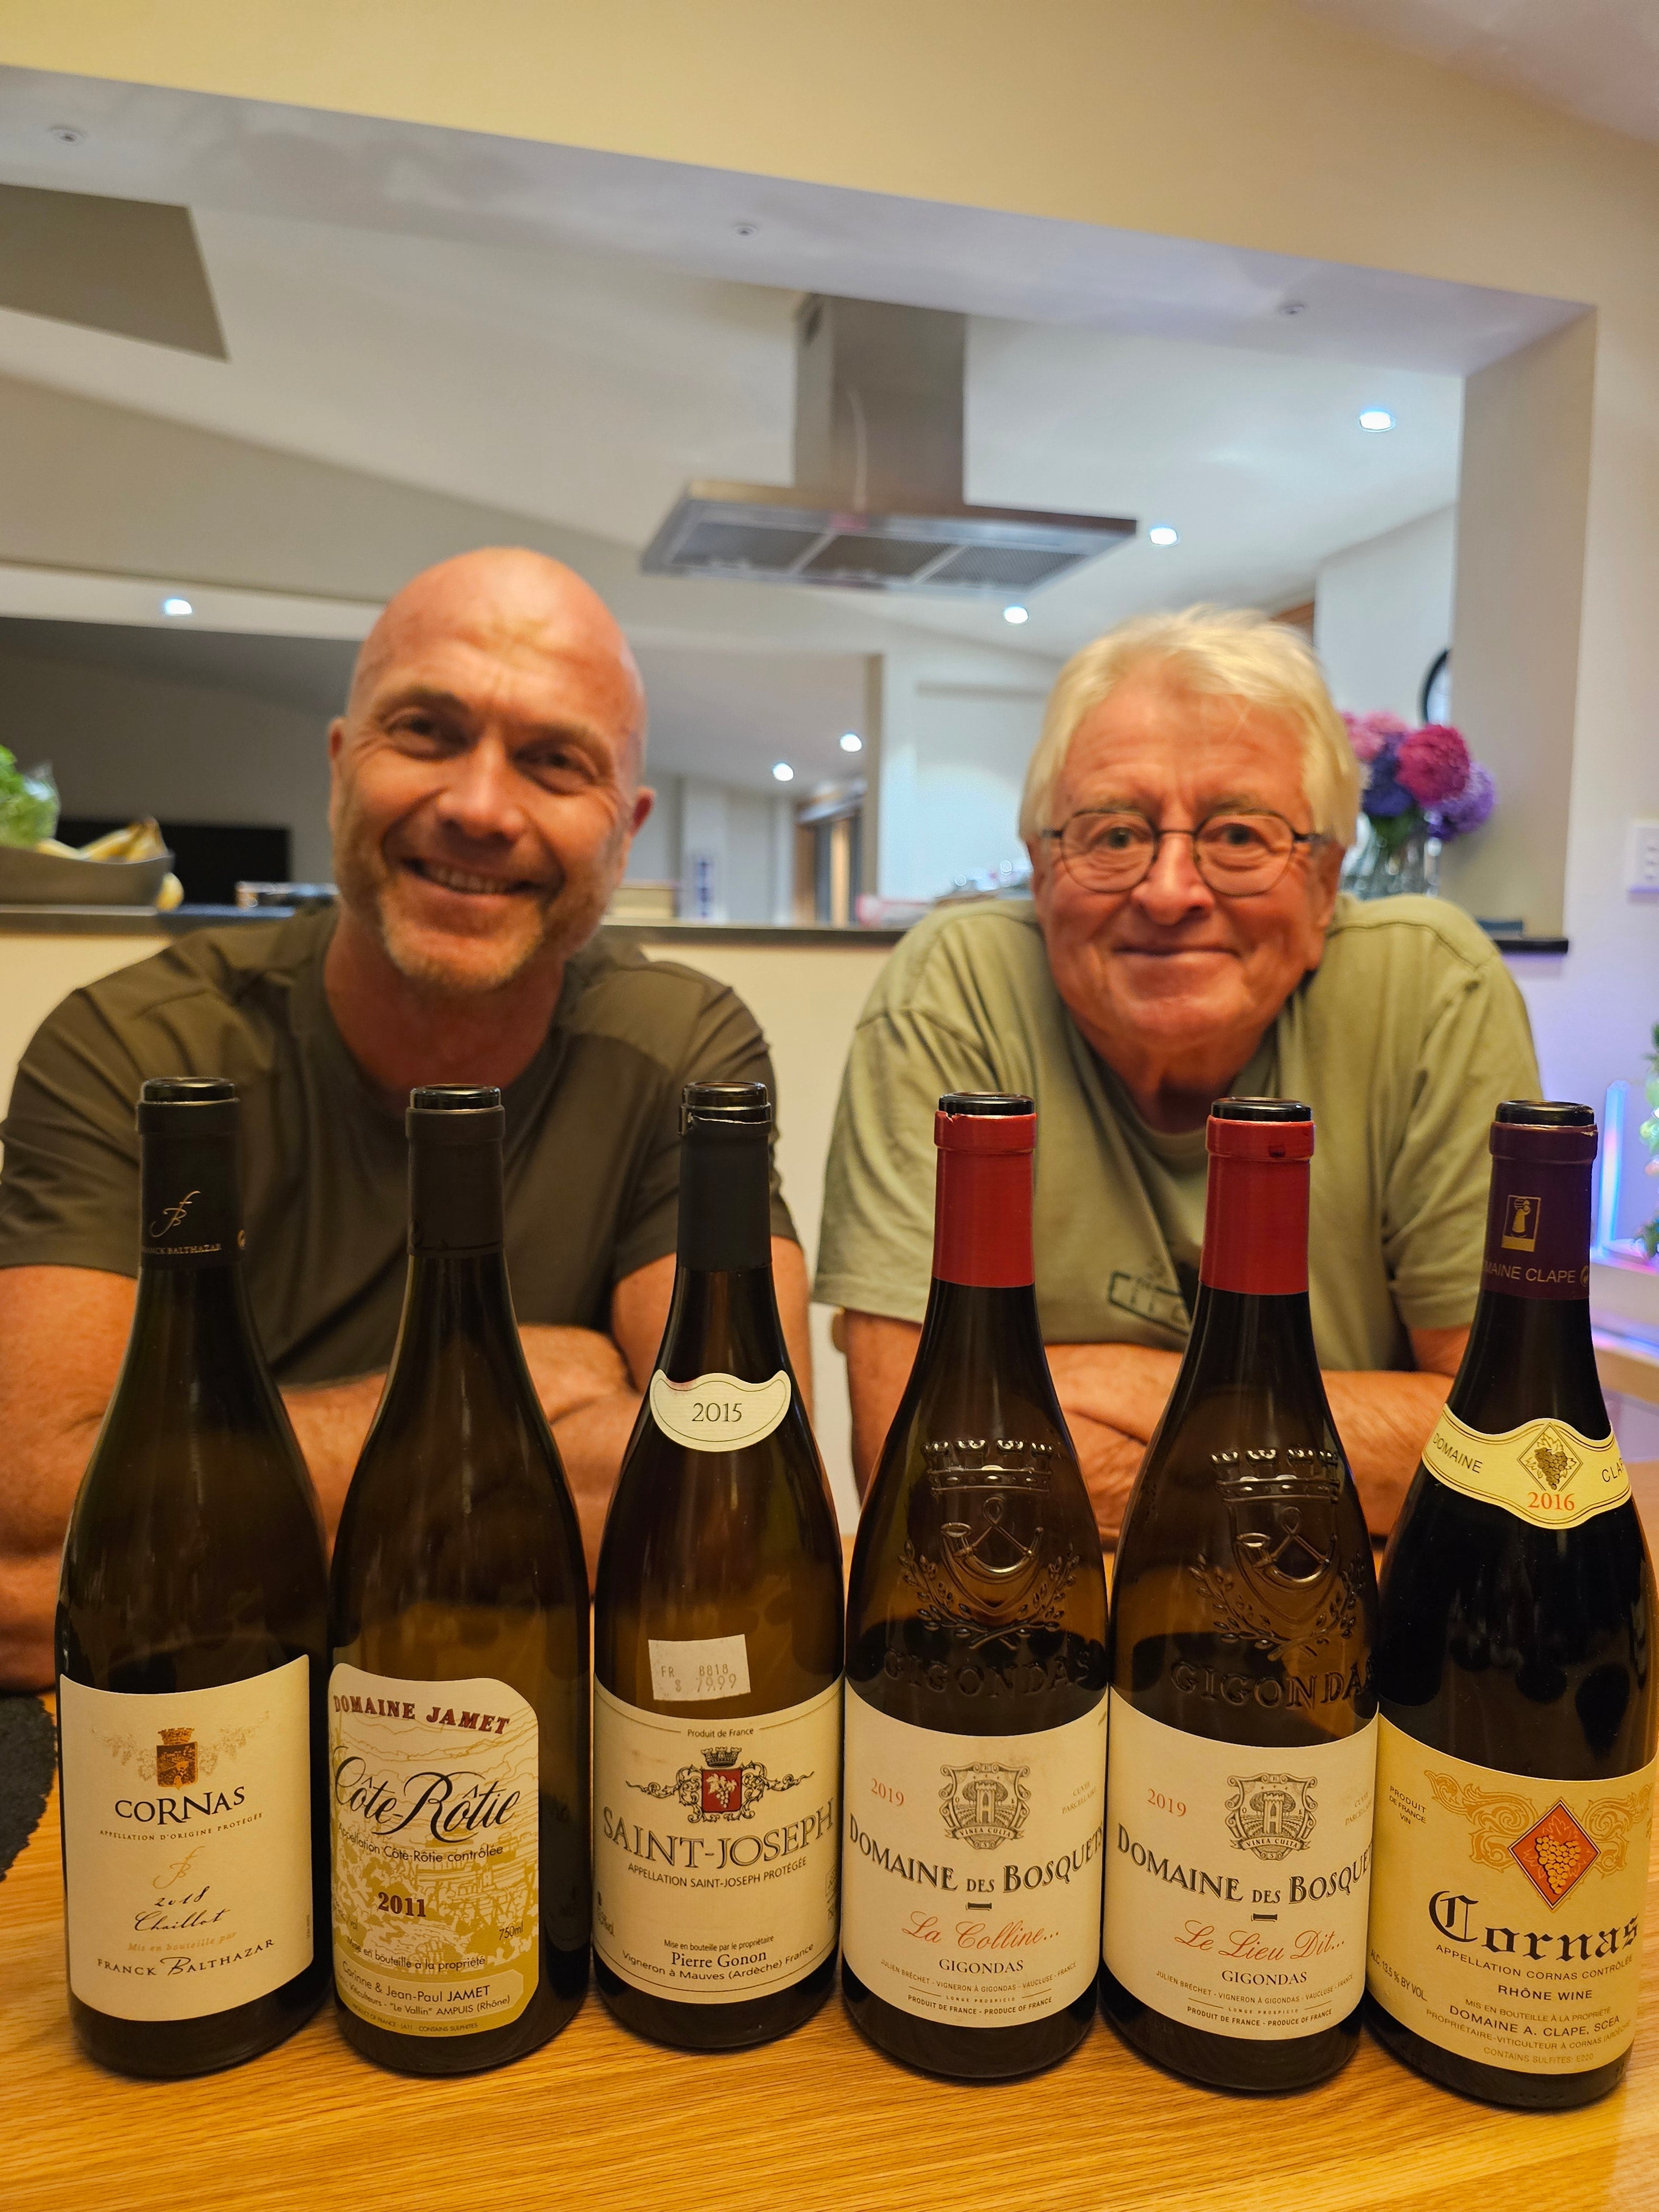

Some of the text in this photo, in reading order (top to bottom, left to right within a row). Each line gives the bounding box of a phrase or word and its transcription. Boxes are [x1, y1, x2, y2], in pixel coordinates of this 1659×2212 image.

[1525, 1267, 1575, 1283] CLAPE
[691, 1402, 742, 1422] 2015
[1432, 1433, 1483, 1474] DOMAINE
[1527, 1491, 1575, 1511] 2016
[661, 1663, 729, 1678] FR 8818
[333, 1695, 510, 1734] DOMAINE JAMET
[687, 1728, 754, 1738] Produit de France
[114, 1786, 245, 1825] CORNAS
[332, 1745, 521, 1843] Côte-Rôtie
[871, 1777, 905, 1807] 2019
[1147, 1788, 1186, 1818] 2019
[1389, 1785, 1427, 1813] PRODUIT
[1389, 1795, 1426, 1824] DE FRANCE
[1399, 1812, 1411, 1825] VIN
[100, 1812, 263, 1840] APPELLATION D'ORIGINE PROTÉGÉE
[603, 1797, 834, 1870] SAINT-JOSEPH
[959, 1827, 1011, 1838] VINEA CULTA
[338, 1823, 503, 1862] Appellation Côte-Rôtie contrôlée
[849, 1813, 958, 1891] DOMAINE
[966, 1878, 995, 1893] DES
[1246, 1838, 1297, 1848] VINEA CULTA
[628, 1855, 807, 1888] APPELLATION SAINT-JOSEPH PROTÉGÉE
[1118, 1822, 1244, 1902] DOMAINE
[1251, 1889, 1280, 1904] DES
[154, 1886, 210, 1907] 2018
[378, 1892, 426, 1917] 2011
[134, 1908, 231, 1932] Chaillot
[499, 1921, 524, 1940] 750ml
[901, 1911, 1059, 1950] La Colline...
[1428, 1890, 1639, 1962] Cornas
[128, 1942, 145, 1952] Mis
[166, 1937, 216, 1952] bouteille
[218, 1932, 237, 1945] par
[664, 1934, 774, 1953] Mise en bouteille par le propriétaire
[1174, 1919, 1344, 1961] Le Lieu Dit...
[97, 1939, 274, 1976] FRANCK BALTHAZAR
[347, 1937, 486, 1973] Mise en bouteille à la propriété
[622, 1943, 814, 1980] Vigneron à Mauves (Ardèche) France
[670, 1950, 767, 1968] Pierre Gonon
[938, 1958, 1024, 1974] GIGONDAS
[1436, 1944, 1633, 1981] APPELLATION CORNAS CONTRÔLÉE
[343, 1961, 372, 1989] Corinne
[375, 1983, 382, 1993] &
[386, 1985, 442, 2002] Jean-Paul
[447, 1985, 490, 2002] JAMET
[901, 1969, 930, 1984] BRÉCHET
[936, 1980, 972, 1992] VIGNERON
[974, 1984, 979, 1992] À
[980, 1984, 1016, 1993] GIGONDAS
[1022, 1974, 1053, 1989] VAUCLUSE
[1057, 1960, 1077, 1977] FRANCE
[1155, 1970, 1354, 2004] JULIEN BRÉCHET VIGNERON À GIGONDAS VAUCLUSE FRANCE
[1221, 1970, 1307, 1986] GIGONDAS
[1394, 1971, 1400, 1984] %
[1401, 1976, 1410, 1990] BY
[436, 2005, 473, 2016] AMPUIS
[477, 1995, 510, 2012] (Rhône)
[907, 1994, 1052, 2015] PRODUIT DE FRANCE PRODUCE OF FRANCE
[946, 1995, 969, 2003] LONGE
[1498, 1984, 1593, 2001] RHÔNE WINE
[1187, 2006, 1333, 2027] PRODUIT DE FRANCE PRODUCE OF FRANCE
[1449, 2005, 1620, 2037] DOMAINE A. CLAPE, SCEA
[1464, 1998, 1611, 2023] MIS EN BOUTEILLE À LA PROPRIÉTÉ
[1426, 2008, 1558, 2051] PROPRIÉTAIRE-VITICULTEUR
[1561, 2039, 1567, 2050] À
[1568, 2036, 1602, 2050] CORNAS
[1483, 2046, 1594, 2064] CONTAINS SULFITES: E220
